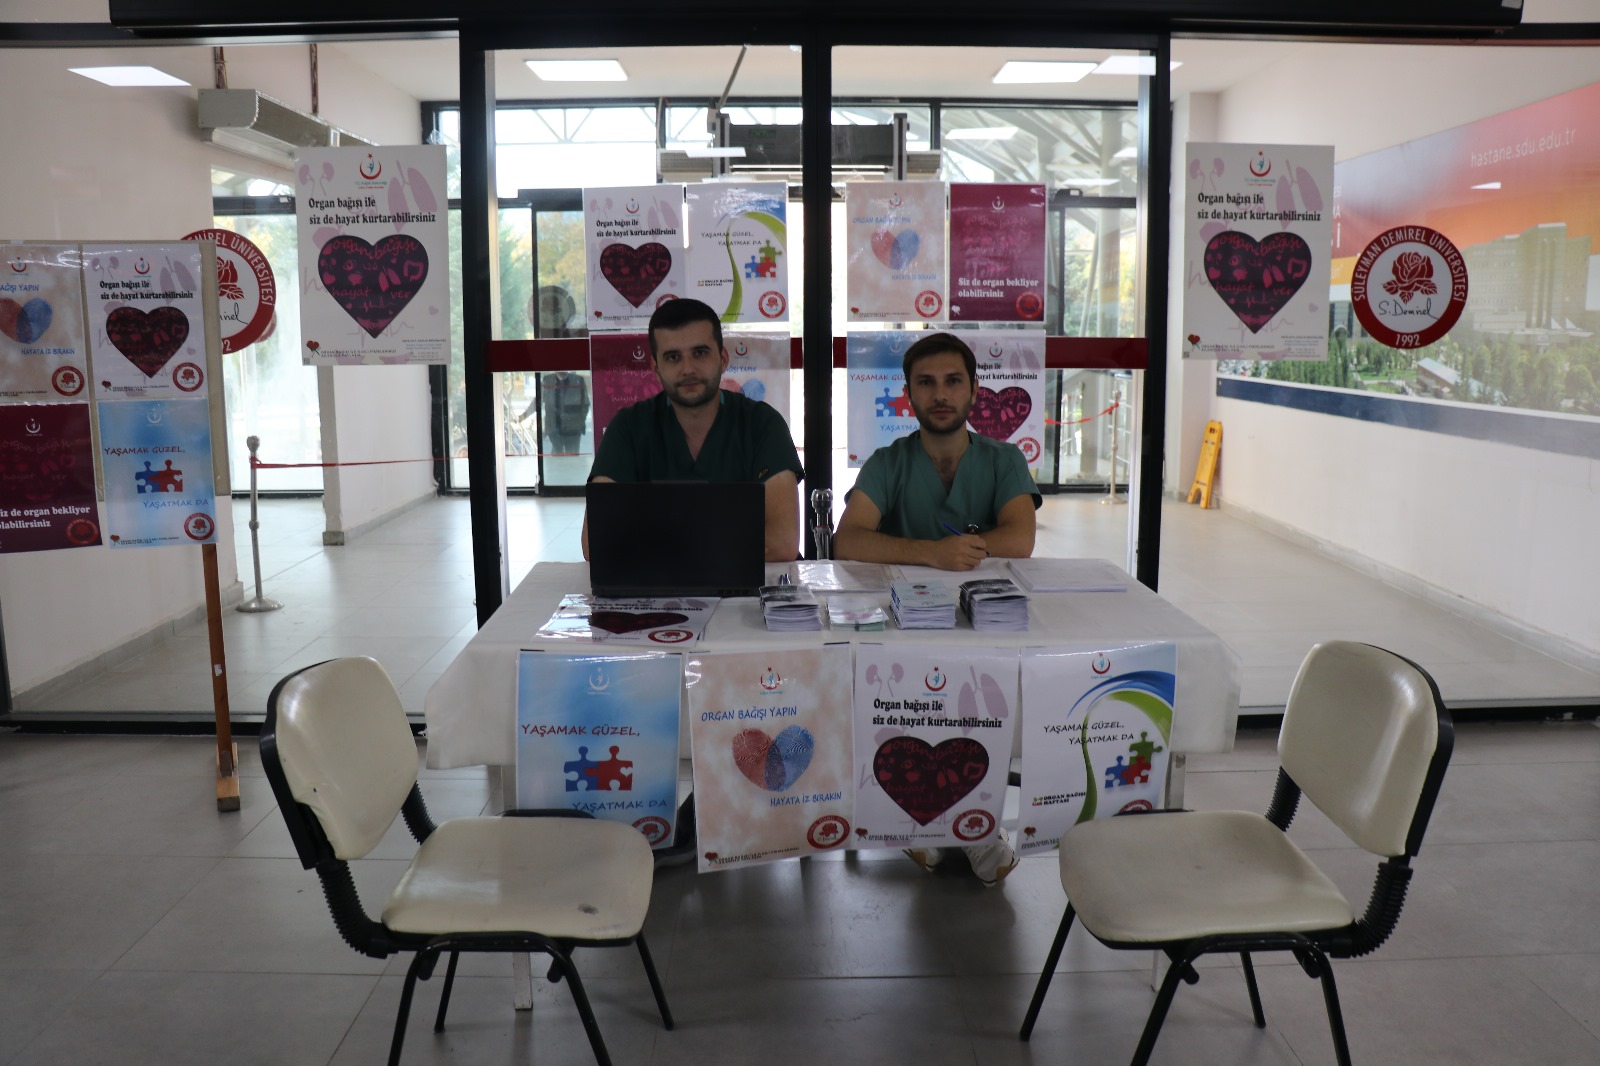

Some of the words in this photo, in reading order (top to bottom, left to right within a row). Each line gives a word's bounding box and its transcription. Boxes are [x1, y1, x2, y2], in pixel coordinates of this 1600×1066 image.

[1471, 128, 1577, 168] hastane.sdu.edu.tr
[308, 197, 335, 210] Organ
[337, 197, 363, 210] bağışı
[364, 197, 376, 207] ile
[1197, 192, 1224, 206] Organ
[1226, 193, 1251, 206] bağışı
[1253, 193, 1264, 204] ile
[309, 214, 321, 224] siz
[323, 214, 334, 224] de
[336, 214, 360, 226] hayat
[362, 212, 436, 224] kurtarabilirsiniz
[1197, 209, 1209, 219] siz
[1211, 209, 1222, 219] de
[1223, 209, 1247, 222] hayat
[1249, 210, 1321, 221] kurtarabilirsiniz
[596, 219, 614, 228] Organ
[1351, 243, 1382, 302] SÜLEYMAN
[1380, 226, 1427, 247] DEMİREL
[1429, 230, 1468, 303] ÜNİVERSİTESİ
[0, 283, 17, 293] AĞIŞI
[19, 284, 40, 292] YAPIN
[100, 280, 120, 290] Organ
[958, 278, 970, 286] Siz
[971, 278, 981, 286] de
[982, 279, 1005, 287] organ
[1006, 278, 1039, 288] bekliyor
[120, 292, 139, 300] hayat
[958, 289, 1004, 298] olabilirsiniz
[1395, 333, 1421, 347] 1992
[880, 424, 918, 432] YAŞATMA
[104, 447, 149, 456] YAŞAMAK
[143, 500, 192, 509] YAŞATMAK
[0, 508, 8, 518] iz
[10, 508, 22, 517] de
[23, 508, 50, 519] organ
[52, 505, 91, 516] bekliyor
[873, 698, 901, 711] Organ
[903, 699, 930, 713] bağışı
[931, 700, 943, 711] ile
[701, 710, 735, 722] ORGAN
[738, 706, 767, 721] BAĞIŞI
[769, 706, 797, 717] YAPIN
[872, 715, 885, 725] siz
[887, 715, 898, 726] de
[900, 715, 926, 728] hayat
[927, 716, 1003, 728] kurtarabilirsiniz
[521, 723, 587, 737] YAŞAMAK
[591, 724, 641, 737] GÜZEL,
[1043, 723, 1088, 734] YAŞAMAK
[1069, 734, 1118, 745] YAŞATMAK
[770, 796, 800, 807] HAYATA
[802, 793, 810, 803] İZ
[812, 791, 842, 803] BIRAKIN
[572, 801, 643, 813] YAŞATMAK
[648, 800, 667, 808] DA
